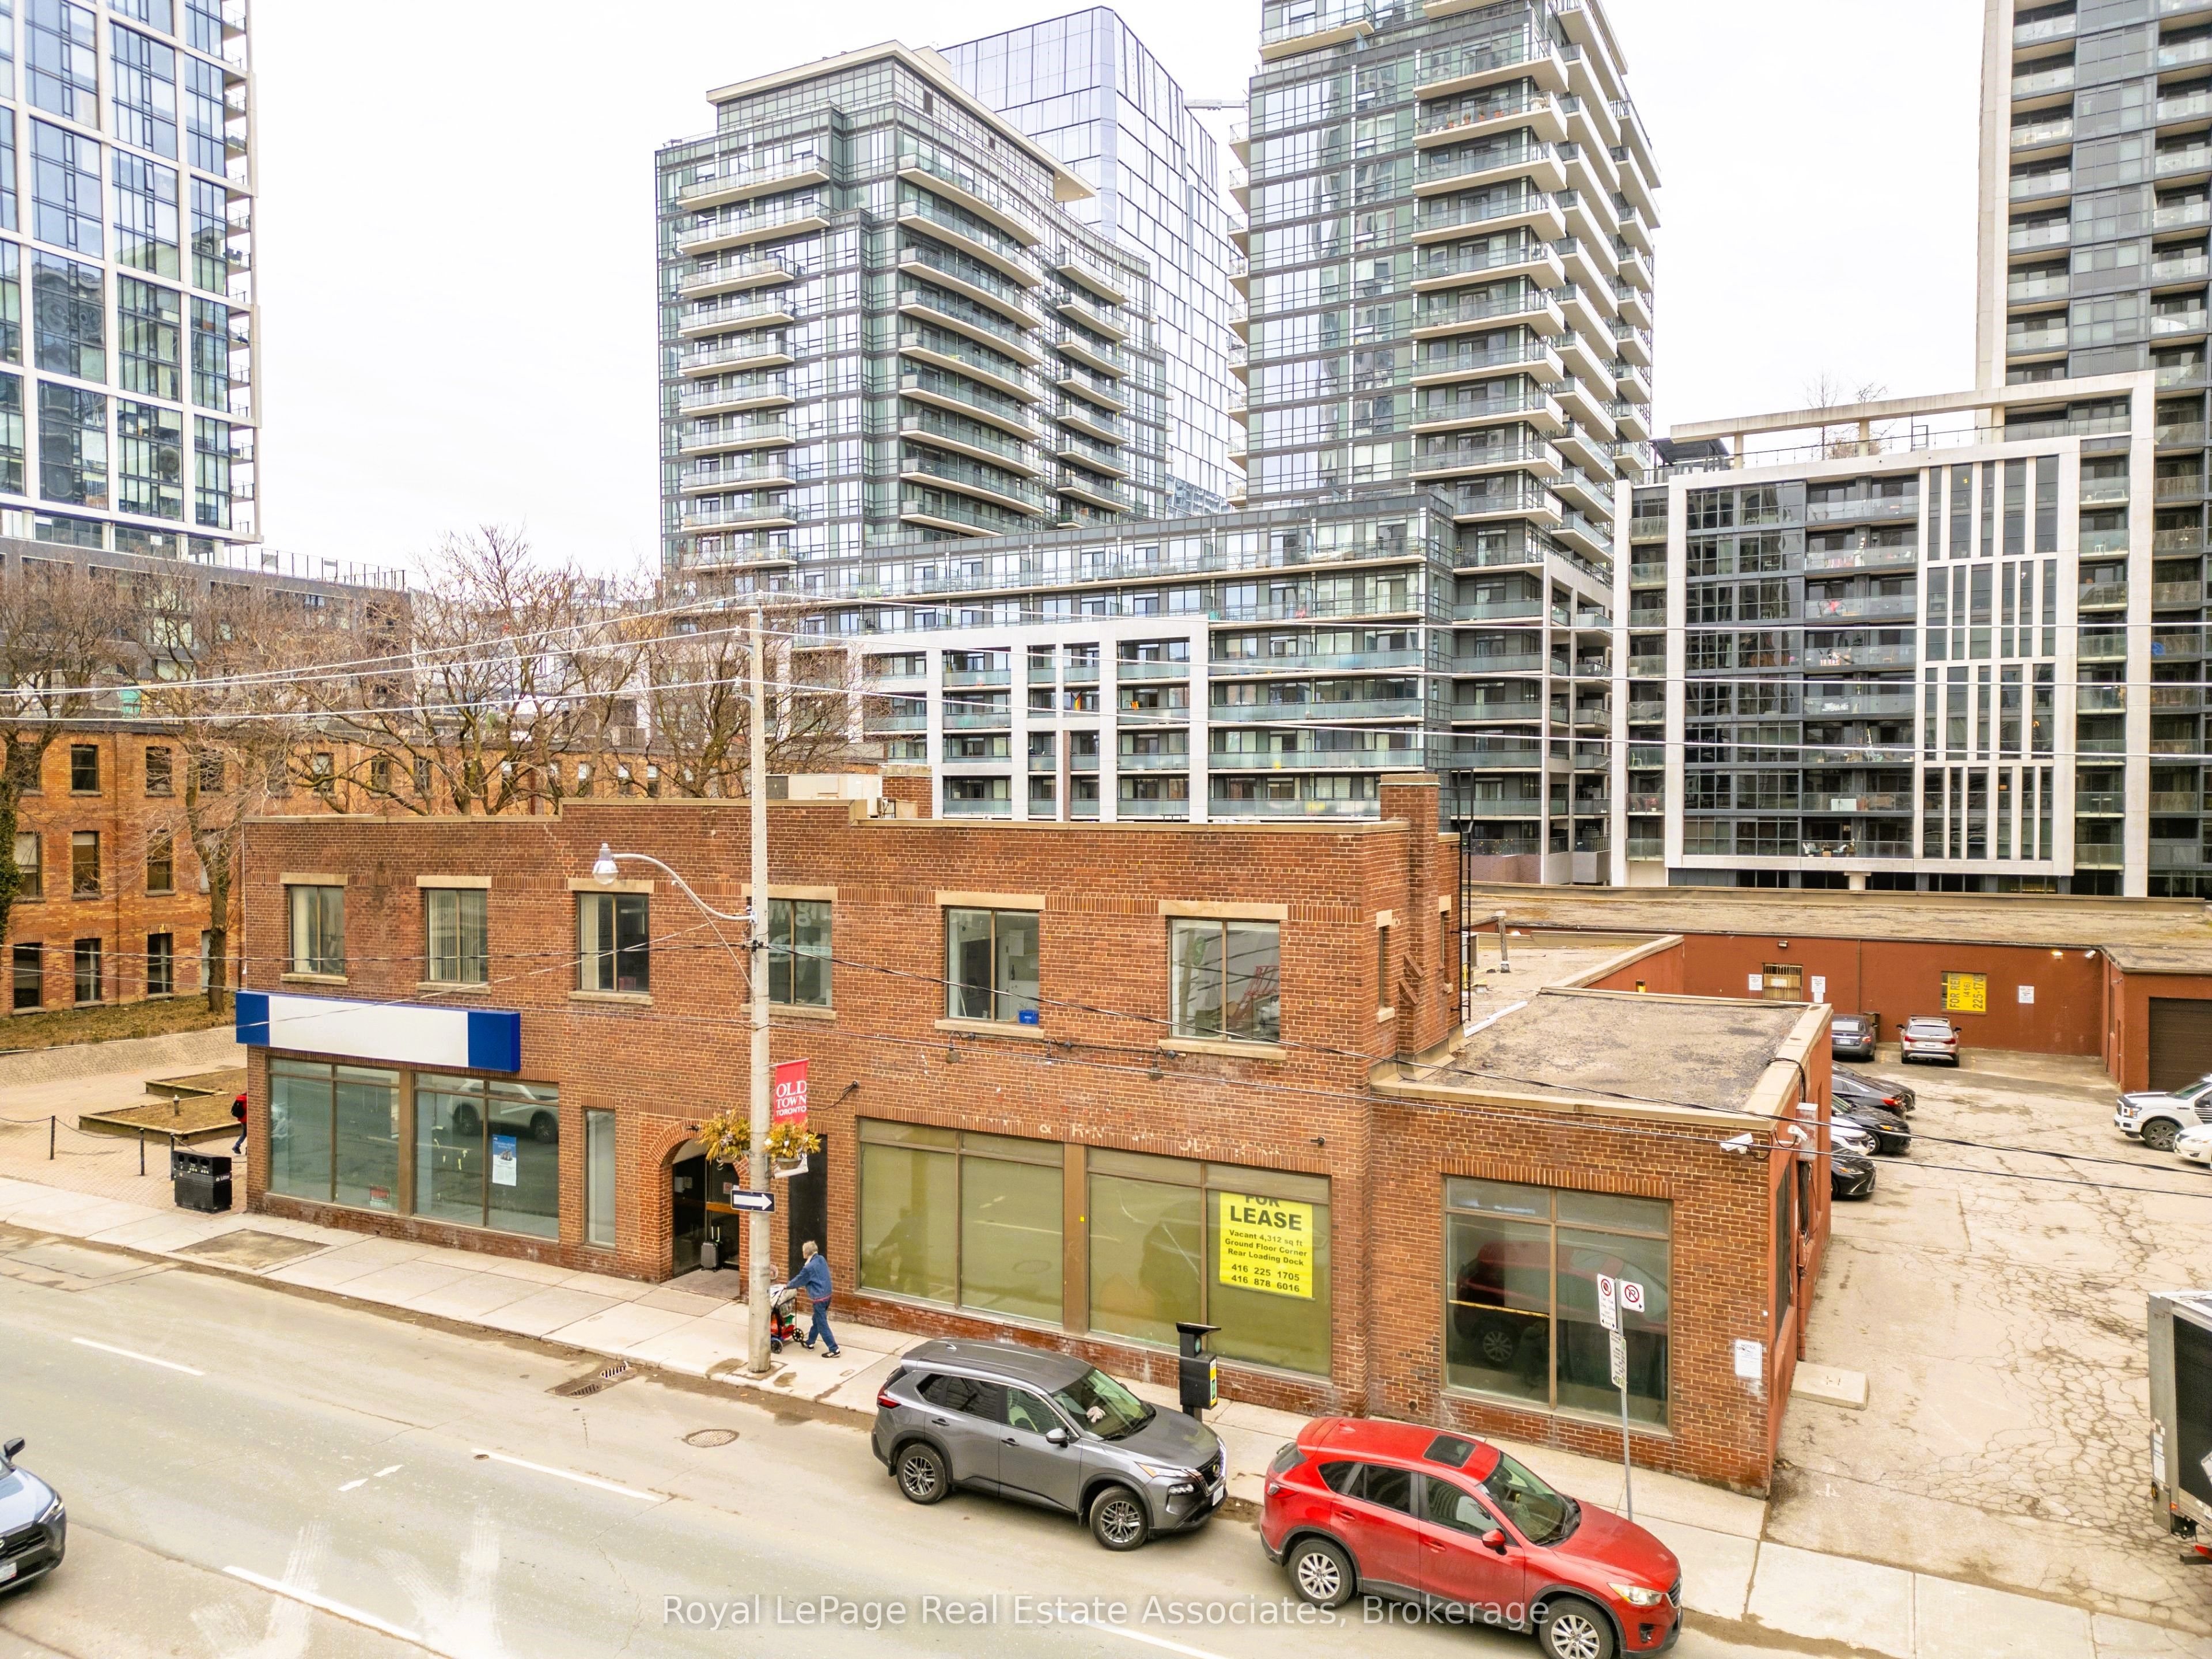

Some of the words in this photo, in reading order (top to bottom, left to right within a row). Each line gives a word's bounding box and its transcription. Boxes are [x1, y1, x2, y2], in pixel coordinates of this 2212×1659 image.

[1963, 982, 1972, 997] (416)
[1949, 993, 1960, 1008] FOR
[776, 1080, 807, 1098] OLD
[776, 1094, 807, 1109] TOWN
[776, 1105, 807, 1117] TORONTO
[1230, 1205, 1302, 1231] LEASE
[1229, 1229, 1257, 1239] Vacant
[1259, 1234, 1282, 1243] 4,312
[1225, 1238, 1253, 1248] Ground
[1256, 1243, 1277, 1252] Floor
[1279, 1247, 1308, 1256] Corner
[1228, 1248, 1246, 1256] Rear
[1249, 1251, 1281, 1263] Loading
[1283, 1257, 1304, 1266] Dock
[1232, 1264, 1248, 1272] 416
[1254, 1267, 1271, 1277] 225
[1277, 1271, 1300, 1281] 1705
[1231, 1275, 1248, 1283] 416
[1254, 1278, 1271, 1287] 878
[1277, 1282, 1300, 1292] 6016
